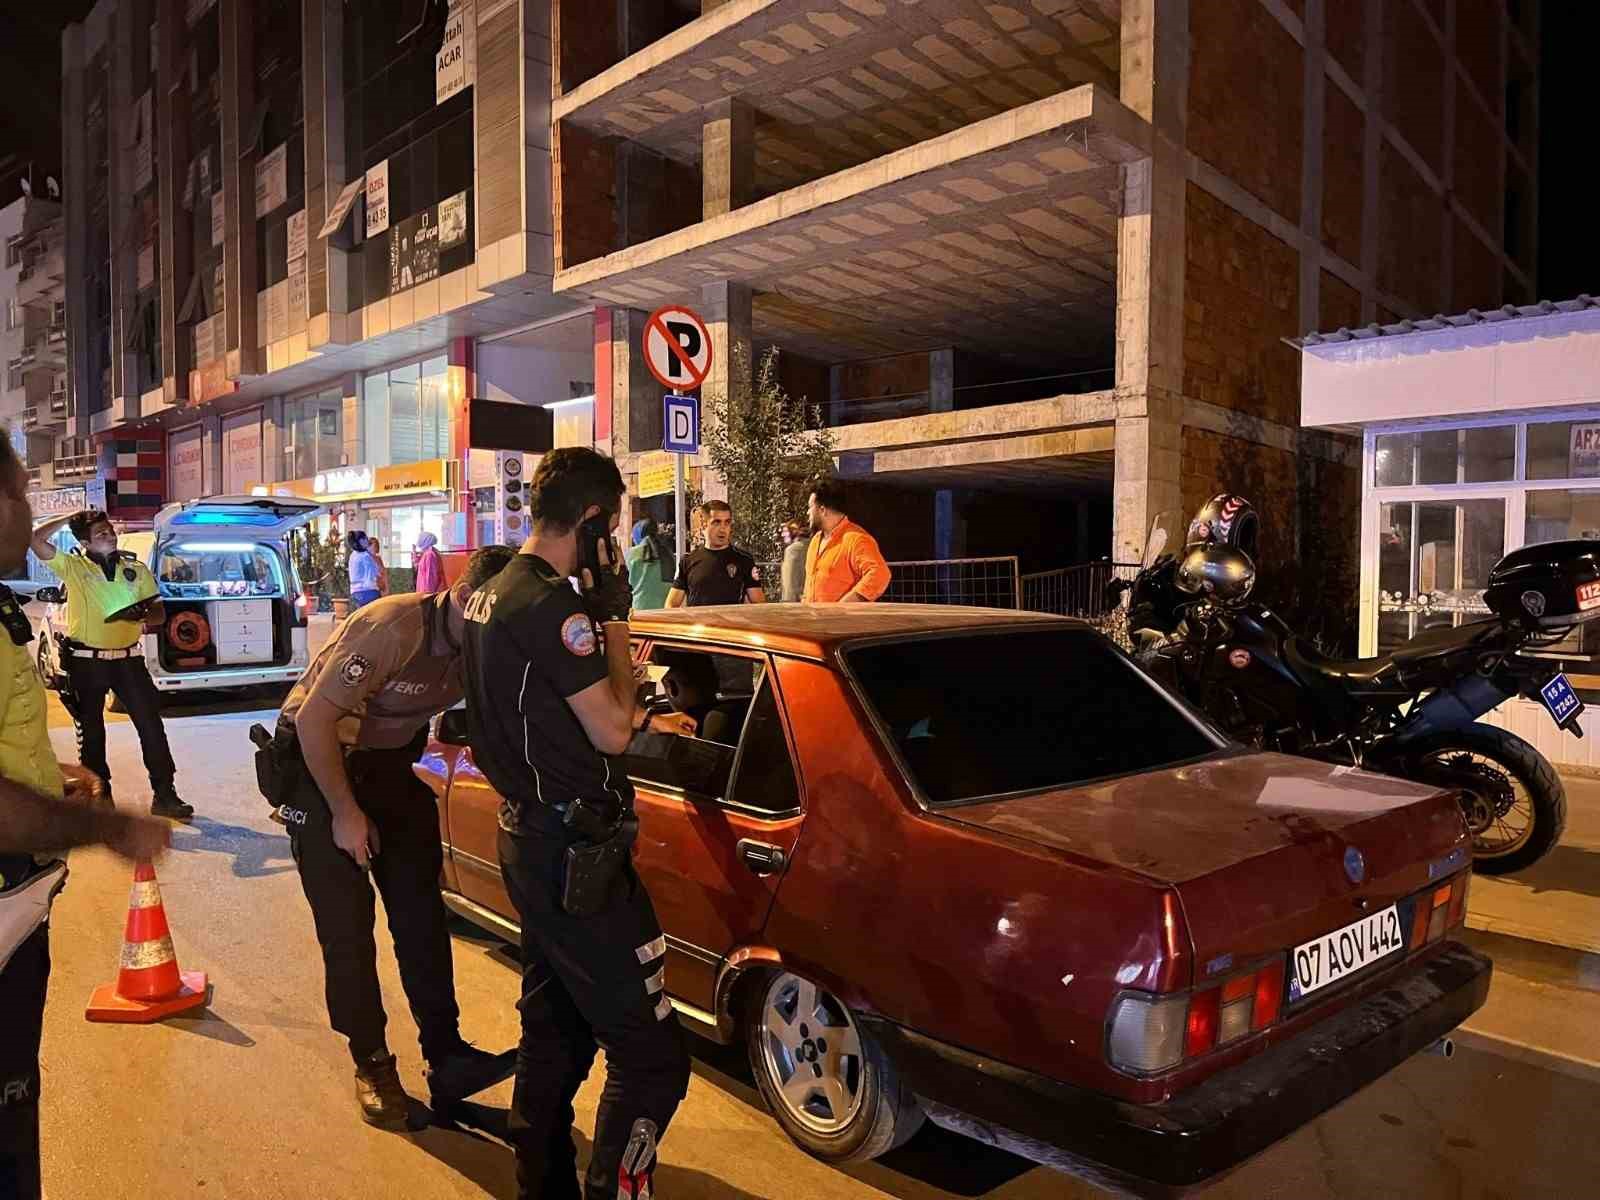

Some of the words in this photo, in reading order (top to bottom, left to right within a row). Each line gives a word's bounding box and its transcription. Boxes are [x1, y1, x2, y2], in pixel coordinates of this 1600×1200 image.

[439, 46, 462, 72] ACAR
[667, 321, 701, 378] P
[675, 410, 688, 439] D
[1548, 687, 1559, 700] 15
[1557, 682, 1566, 693] A
[1297, 943, 1321, 989] 07
[1328, 924, 1365, 978] AOV
[1370, 911, 1401, 955] 442
